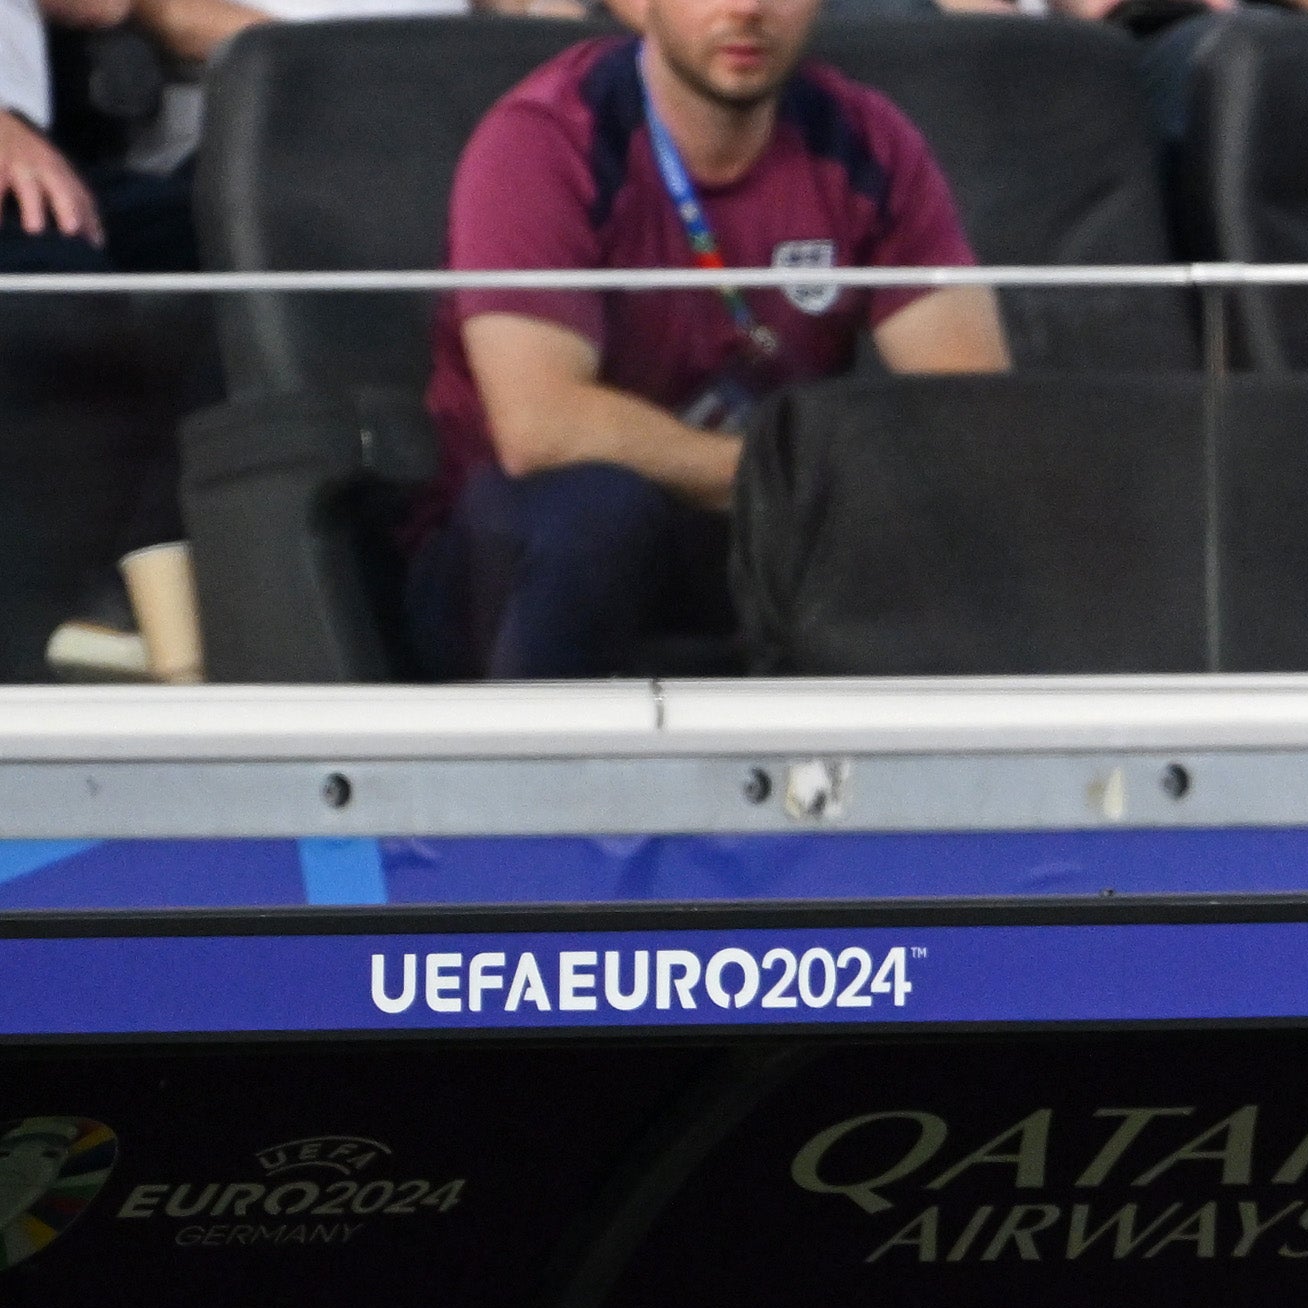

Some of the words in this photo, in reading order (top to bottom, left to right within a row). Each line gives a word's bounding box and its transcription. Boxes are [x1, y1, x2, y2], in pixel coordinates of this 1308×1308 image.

[259, 1143, 378, 1170] UEFA
[116, 1179, 466, 1218] EURO2024
[174, 1223, 365, 1247] GERMANY
